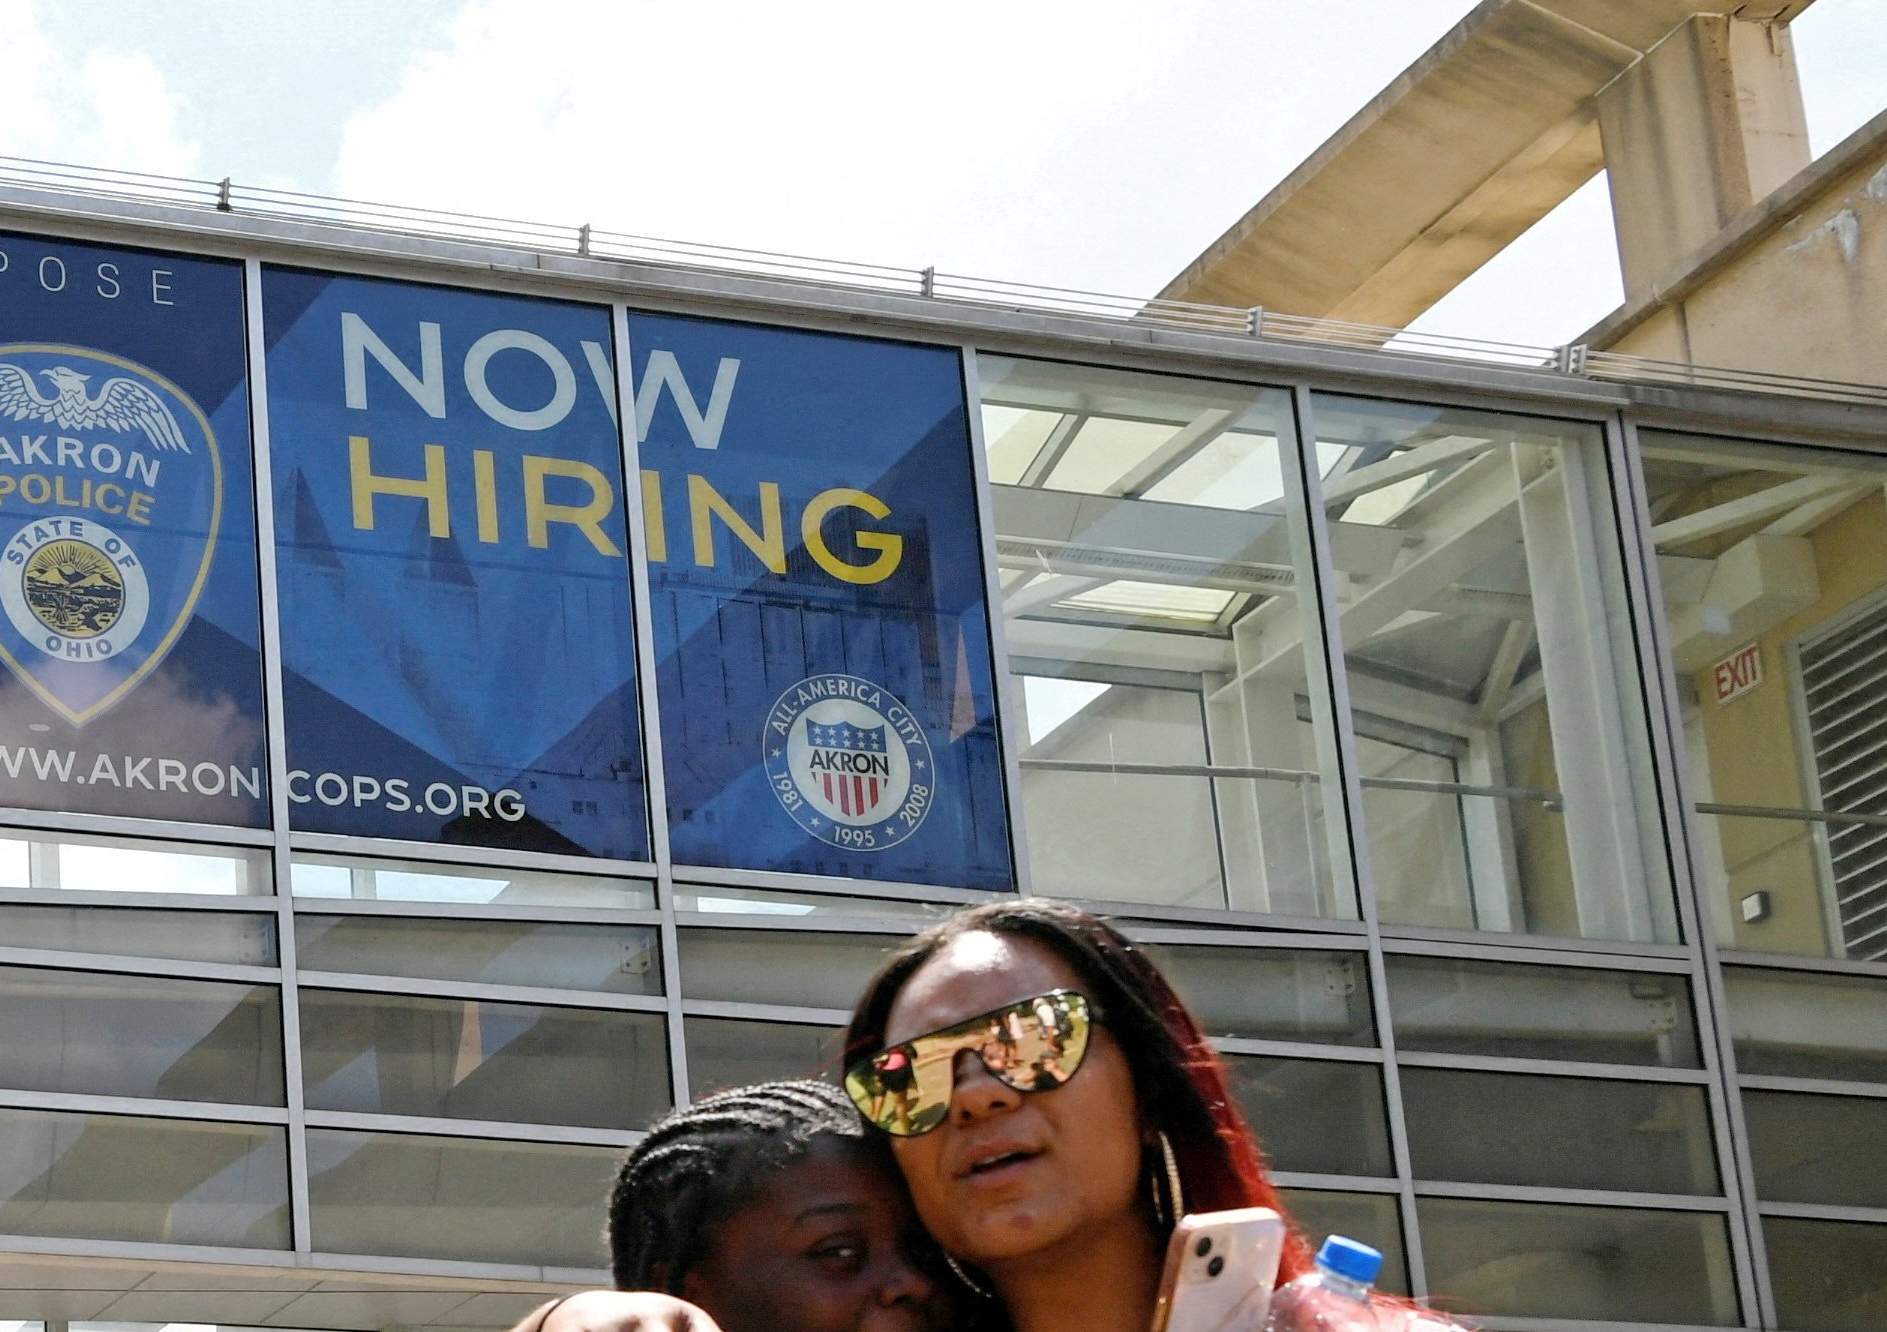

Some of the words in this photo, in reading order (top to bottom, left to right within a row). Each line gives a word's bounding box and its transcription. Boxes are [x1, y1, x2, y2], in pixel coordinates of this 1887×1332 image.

[340, 311, 742, 450] NOW
[348, 435, 904, 585] HIRING
[6, 519, 84, 566] STATE
[104, 537, 137, 570] OF
[45, 635, 113, 659] OHIO
[1714, 646, 1758, 700] EXIT
[771, 679, 881, 736] ALL-AMERICA
[886, 707, 922, 747] CITY
[809, 749, 890, 777] AKRON
[772, 771, 804, 812] 1981
[899, 783, 929, 828] 2008
[833, 825, 876, 848] 1995
